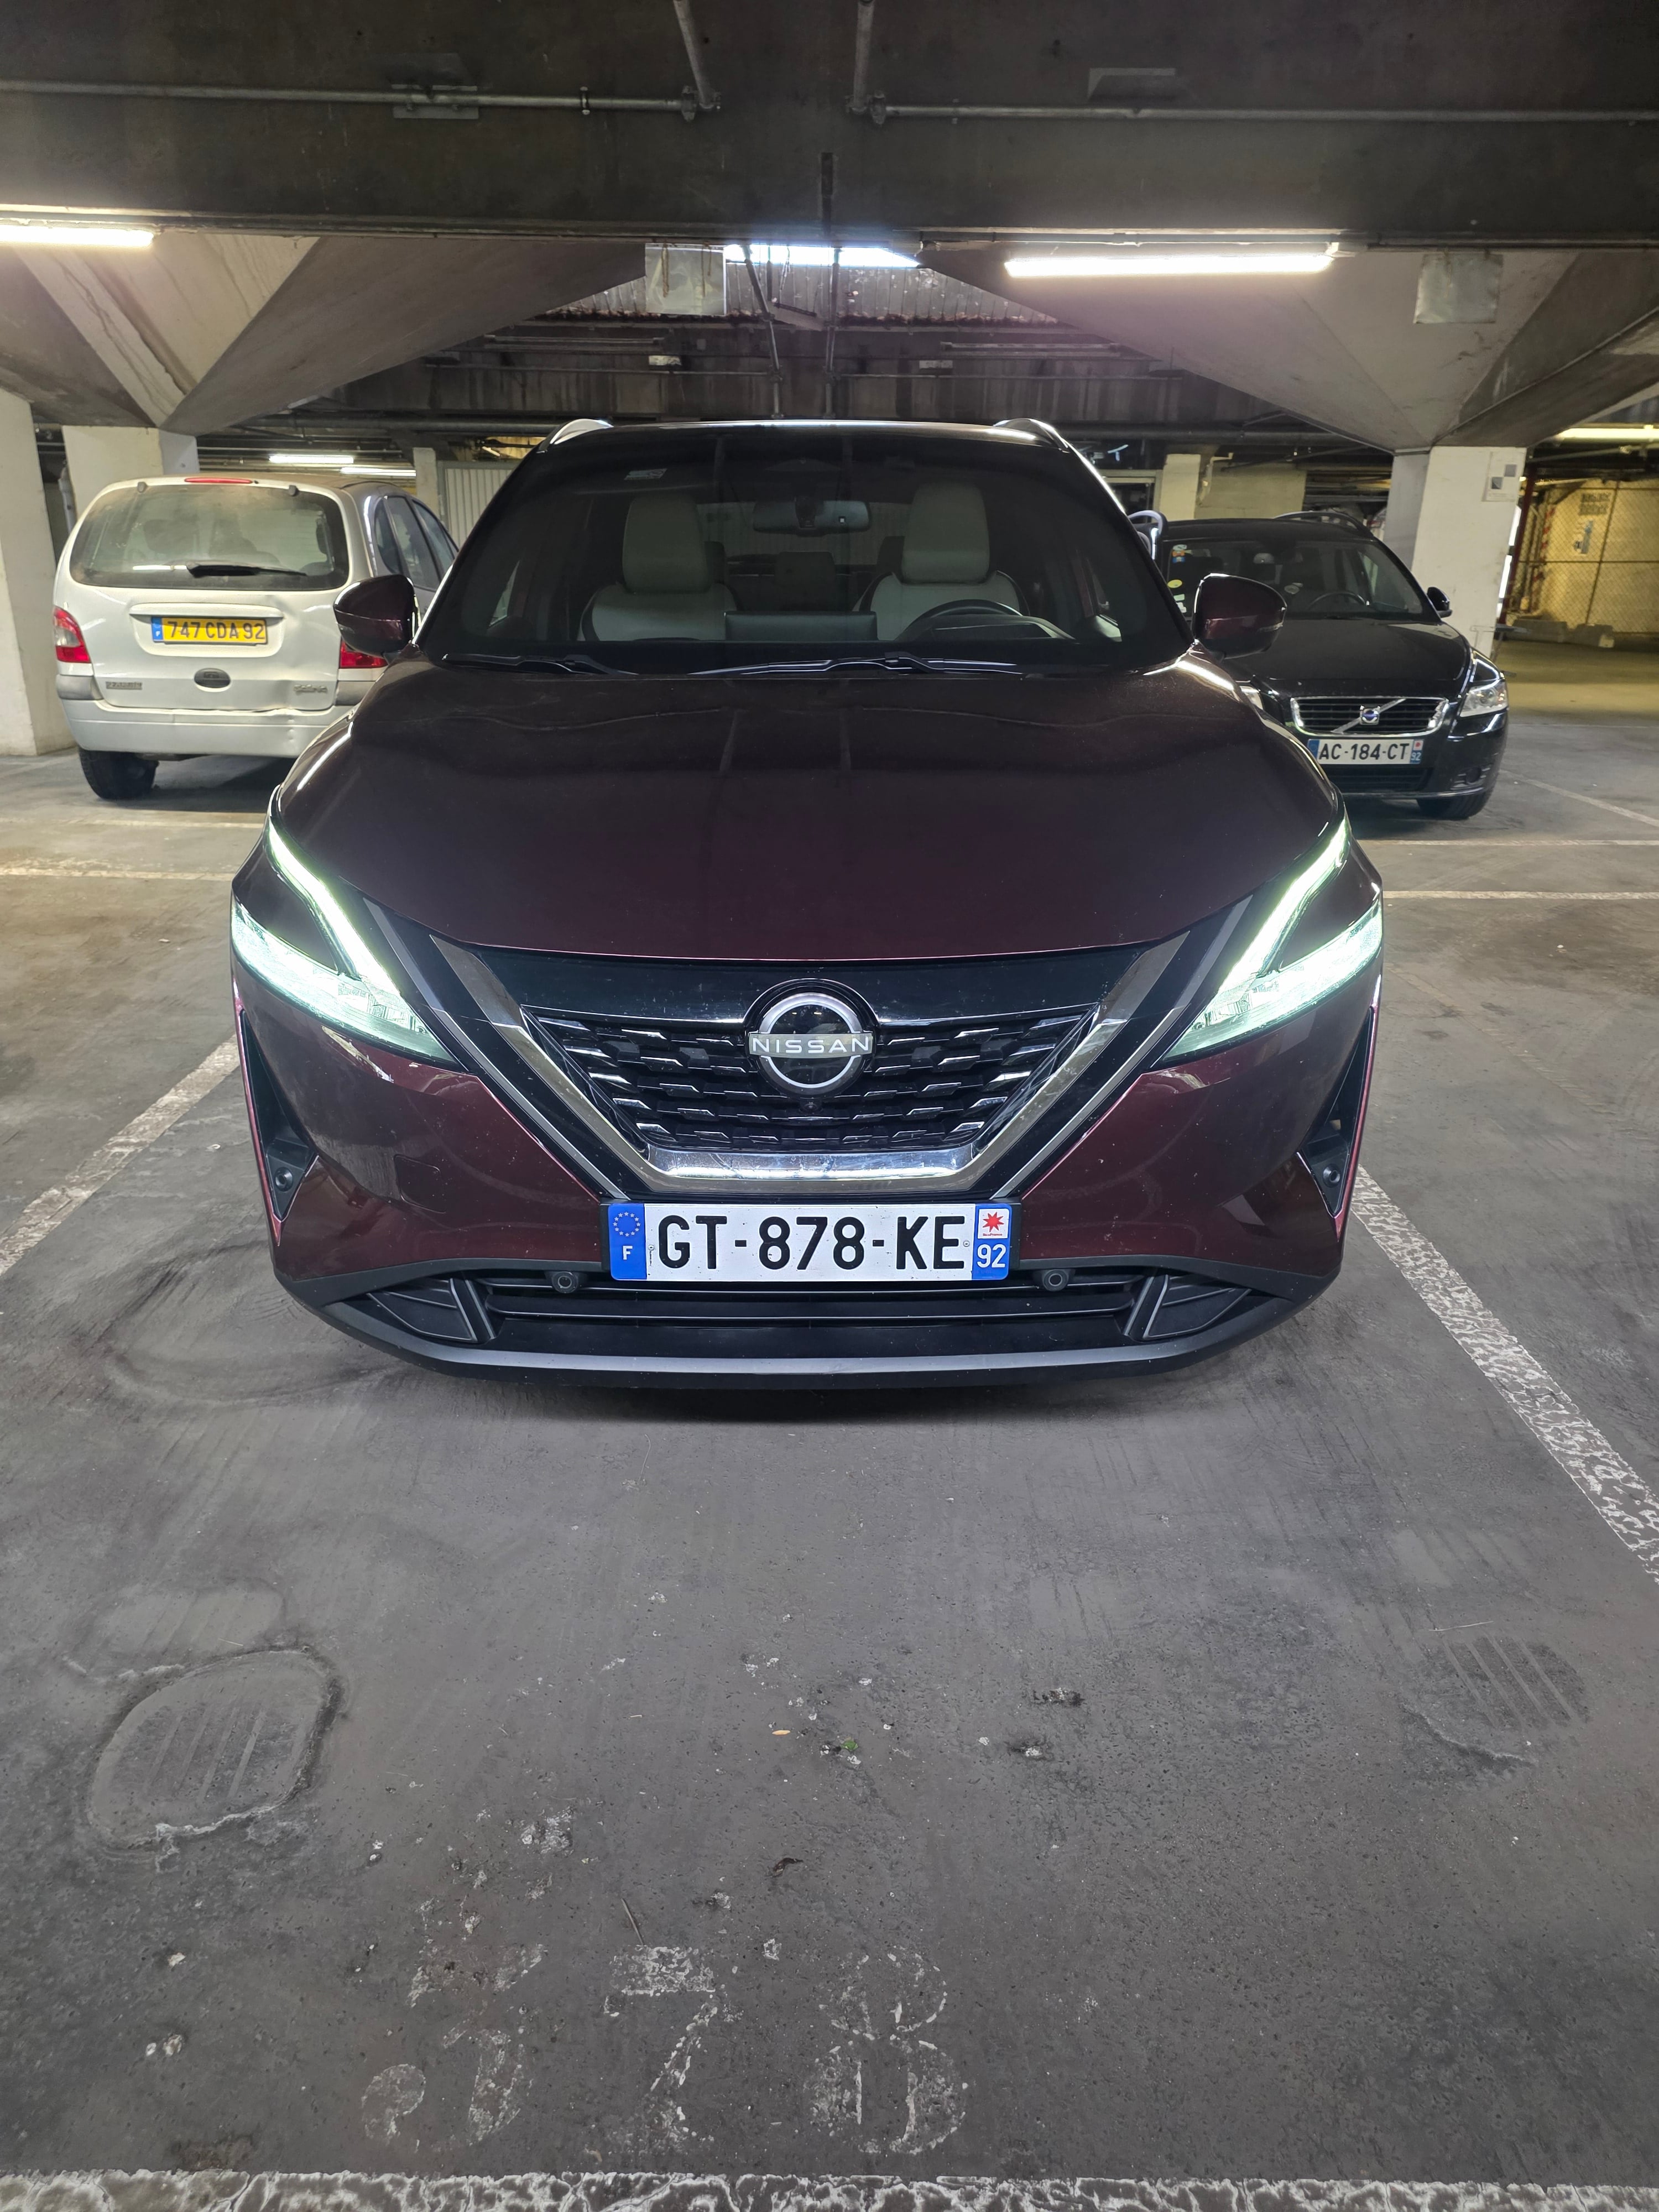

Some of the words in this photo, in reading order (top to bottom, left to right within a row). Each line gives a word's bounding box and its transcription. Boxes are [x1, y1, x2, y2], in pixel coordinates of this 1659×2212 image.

[168, 622, 200, 638] 747
[206, 622, 239, 639] CDA
[243, 623, 265, 639] 92
[1319, 743, 1410, 760] AC-184-CT
[1411, 752, 1422, 761] 92
[752, 1036, 869, 1053] NISSAN
[658, 1215, 965, 1270] GT-878-KE
[623, 1246, 631, 1260] F
[977, 1244, 1006, 1268] 92
